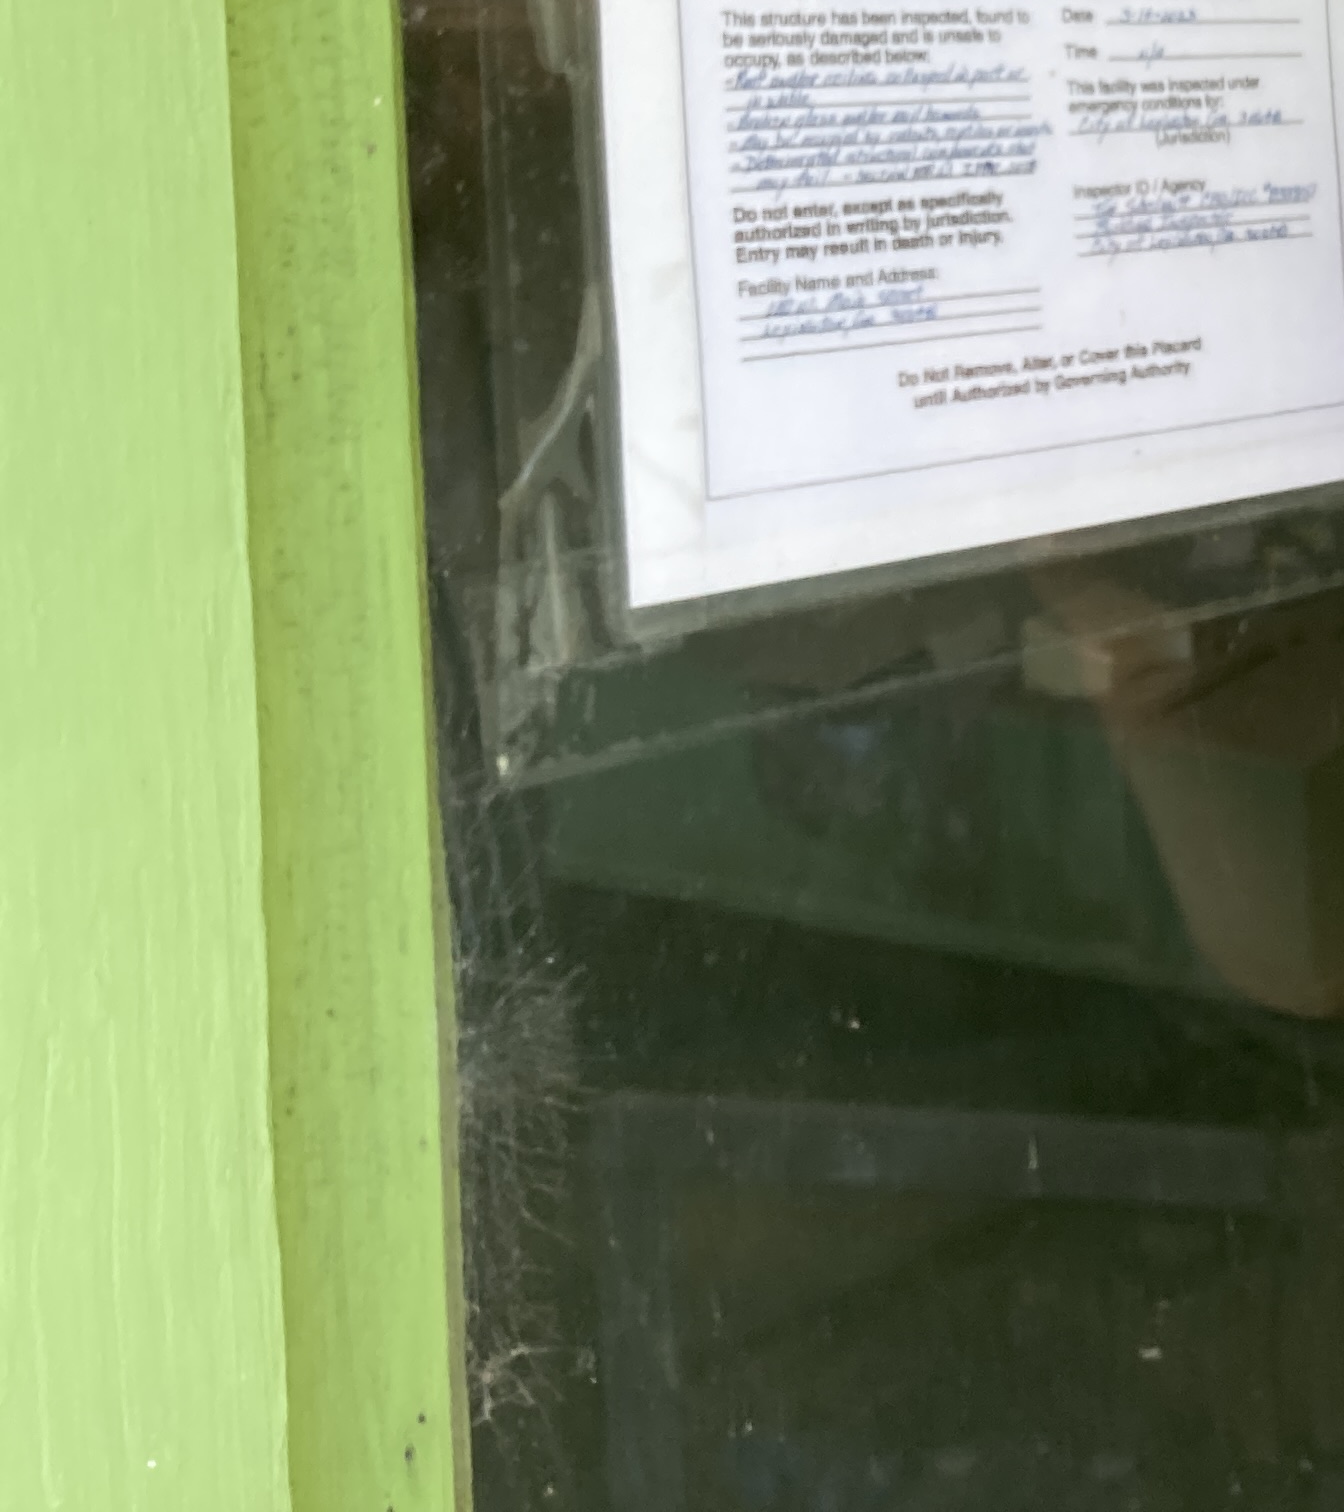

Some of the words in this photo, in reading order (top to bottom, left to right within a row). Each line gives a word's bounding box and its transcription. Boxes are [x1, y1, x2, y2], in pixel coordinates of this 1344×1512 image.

[722, 11, 755, 27] This
[761, 11, 826, 27] structure
[832, 10, 858, 26] has
[862, 10, 896, 25] been
[901, 9, 972, 31] inspected,
[976, 9, 1013, 25] found
[1017, 10, 1030, 24] to
[1061, 8, 1094, 24] Date
[723, 30, 743, 47] be
[749, 30, 814, 50] seriously
[820, 29, 887, 49] damaged
[892, 29, 918, 44] and
[923, 29, 934, 44] is
[939, 28, 983, 44] unsafe
[989, 28, 1001, 43] to
[724, 50, 782, 69] occupy,
[787, 51, 804, 65] as
[810, 48, 881, 65] described
[1064, 43, 1098, 59] Time
[1067, 80, 1094, 95] This
[1098, 78, 1136, 94] facility
[1140, 80, 1165, 93] was
[1169, 77, 1224, 94] inspected
[1228, 77, 1260, 91] under
[1068, 99, 1137, 115] emergency
[1142, 95, 1203, 111] conditions
[1073, 183, 1130, 199] Inspector
[1135, 180, 1150, 194] ID
[1161, 178, 1206, 196] Agency
[734, 207, 757, 223] Do
[763, 205, 787, 221] not
[793, 202, 838, 219] enter,
[842, 198, 893, 217] except
[898, 198, 915, 212] as
[921, 191, 1004, 211] specifically
[734, 223, 822, 243] authorized
[827, 220, 841, 236] in
[847, 217, 898, 237] writing
[903, 214, 921, 233] by
[736, 245, 779, 264] Entry
[786, 244, 817, 262] may
[823, 237, 869, 256] result
[874, 236, 887, 251] in
[892, 233, 934, 251] death
[939, 233, 955, 247] or
[737, 277, 790, 298] Facility
[795, 272, 840, 290] Name
[846, 270, 874, 287] and
[898, 370, 919, 387] Do
[923, 367, 949, 383] Not
[1061, 354, 1074, 367] or
[1078, 348, 1120, 364] Cover
[1123, 343, 1148, 358] this
[1152, 336, 1201, 355] Placard
[914, 389, 947, 409] until
[952, 379, 1031, 402] Authorized
[1035, 379, 1050, 396] by
[1055, 370, 1127, 391] Governing
[1131, 359, 1191, 379] Authority
